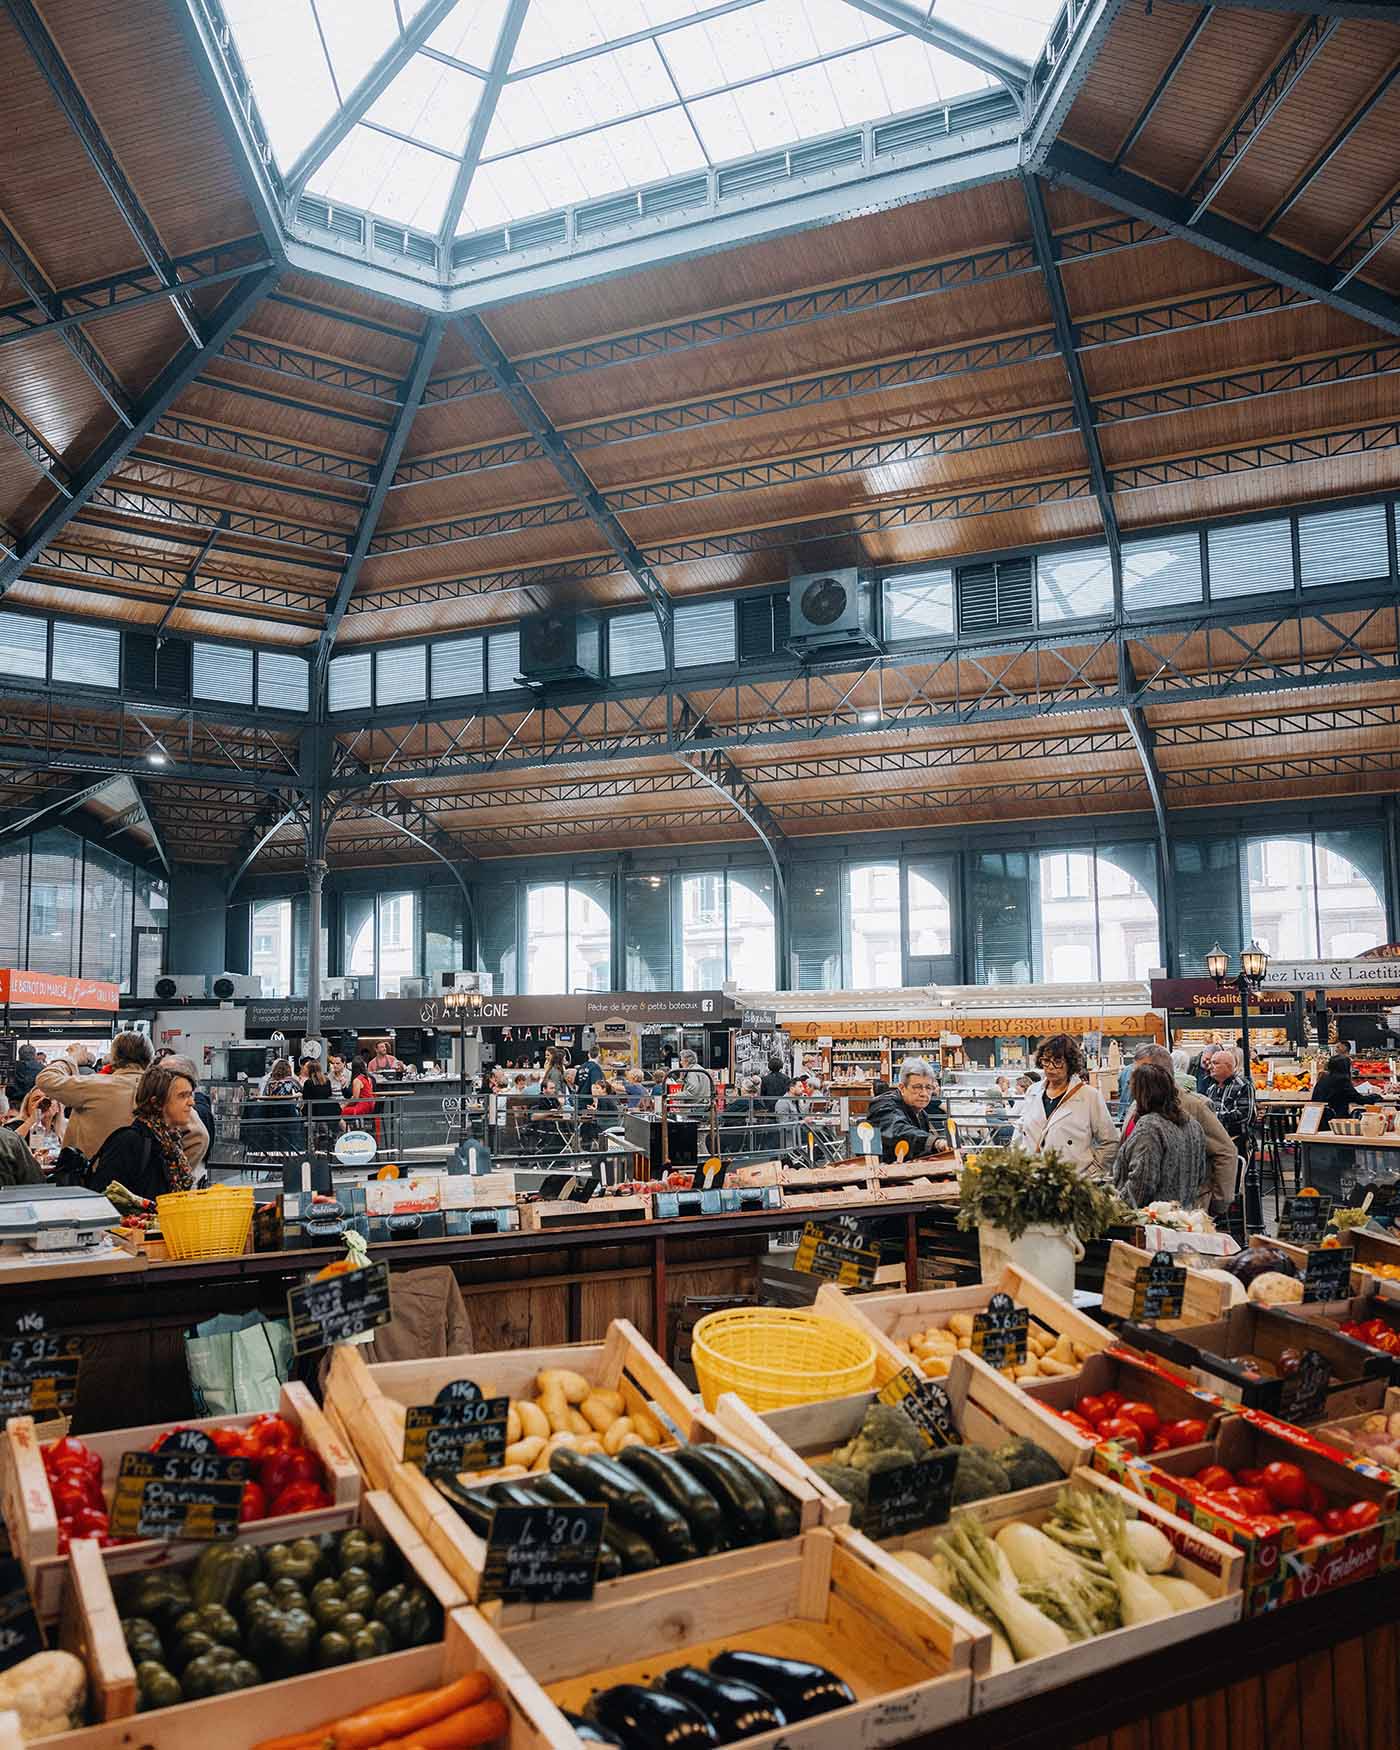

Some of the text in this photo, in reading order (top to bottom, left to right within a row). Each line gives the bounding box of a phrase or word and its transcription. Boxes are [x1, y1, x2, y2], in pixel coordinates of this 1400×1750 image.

[1293, 969, 1325, 982] Ivan
[1330, 967, 1342, 981] &
[588, 1002, 607, 1011] Pêche
[610, 1002, 619, 1010] de
[621, 1002, 638, 1013] ligne
[648, 1001, 667, 1012] petits
[259, 1015, 280, 1024] respect
[281, 1014, 288, 1022] de
[179, 1430, 209, 1454] 1Kg
[123, 1454, 153, 1477] Prix
